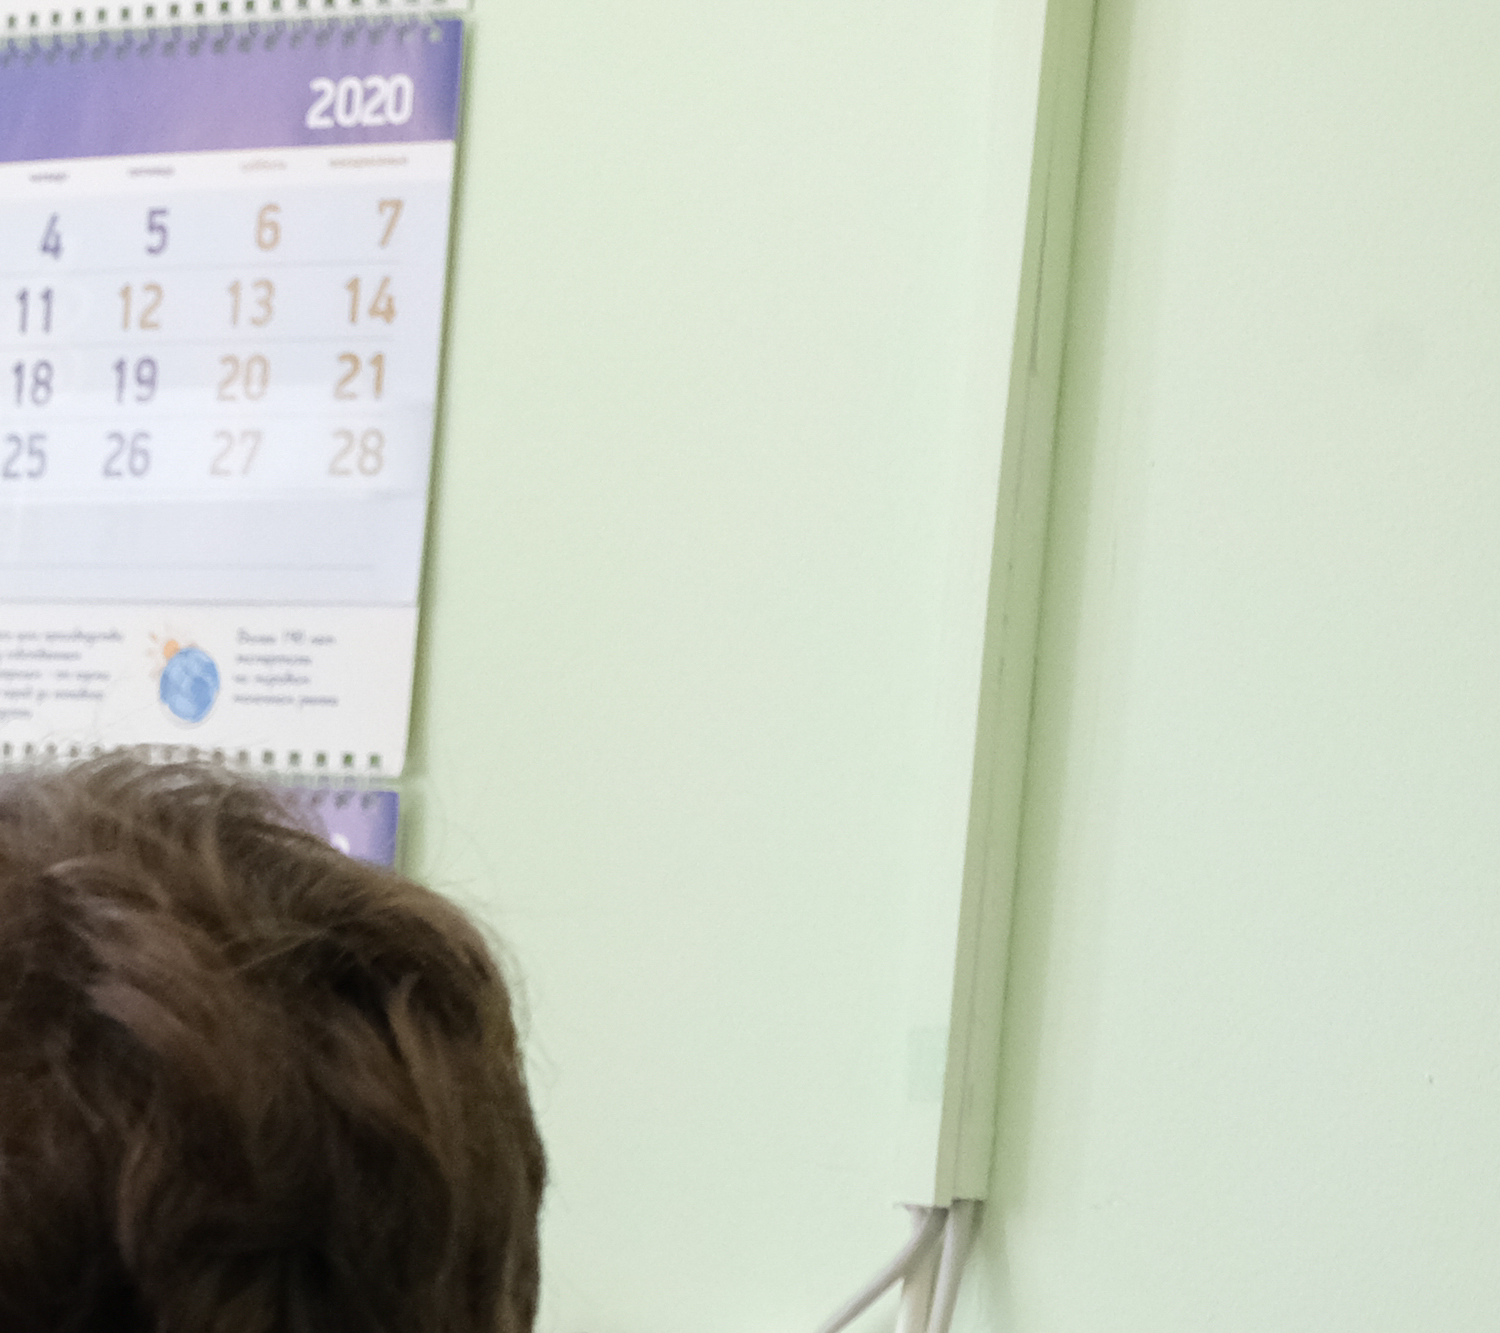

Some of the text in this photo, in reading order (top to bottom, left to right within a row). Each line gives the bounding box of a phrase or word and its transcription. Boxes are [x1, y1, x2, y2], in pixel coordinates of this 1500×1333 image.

[304, 73, 415, 129] 2020
[37, 210, 65, 261] 4
[144, 205, 172, 258] 5
[254, 200, 283, 252] 6
[376, 196, 406, 249] 7
[14, 286, 56, 335] 11
[118, 282, 164, 331] 12
[226, 278, 276, 328] 13
[344, 275, 398, 326] 14
[11, 358, 55, 408] 18
[112, 355, 160, 404] 19
[217, 354, 272, 402] 20
[333, 351, 386, 401] 21
[0, 431, 48, 481] 25
[101, 430, 152, 479] 26
[210, 429, 262, 479] 27
[327, 428, 386, 477] 28
